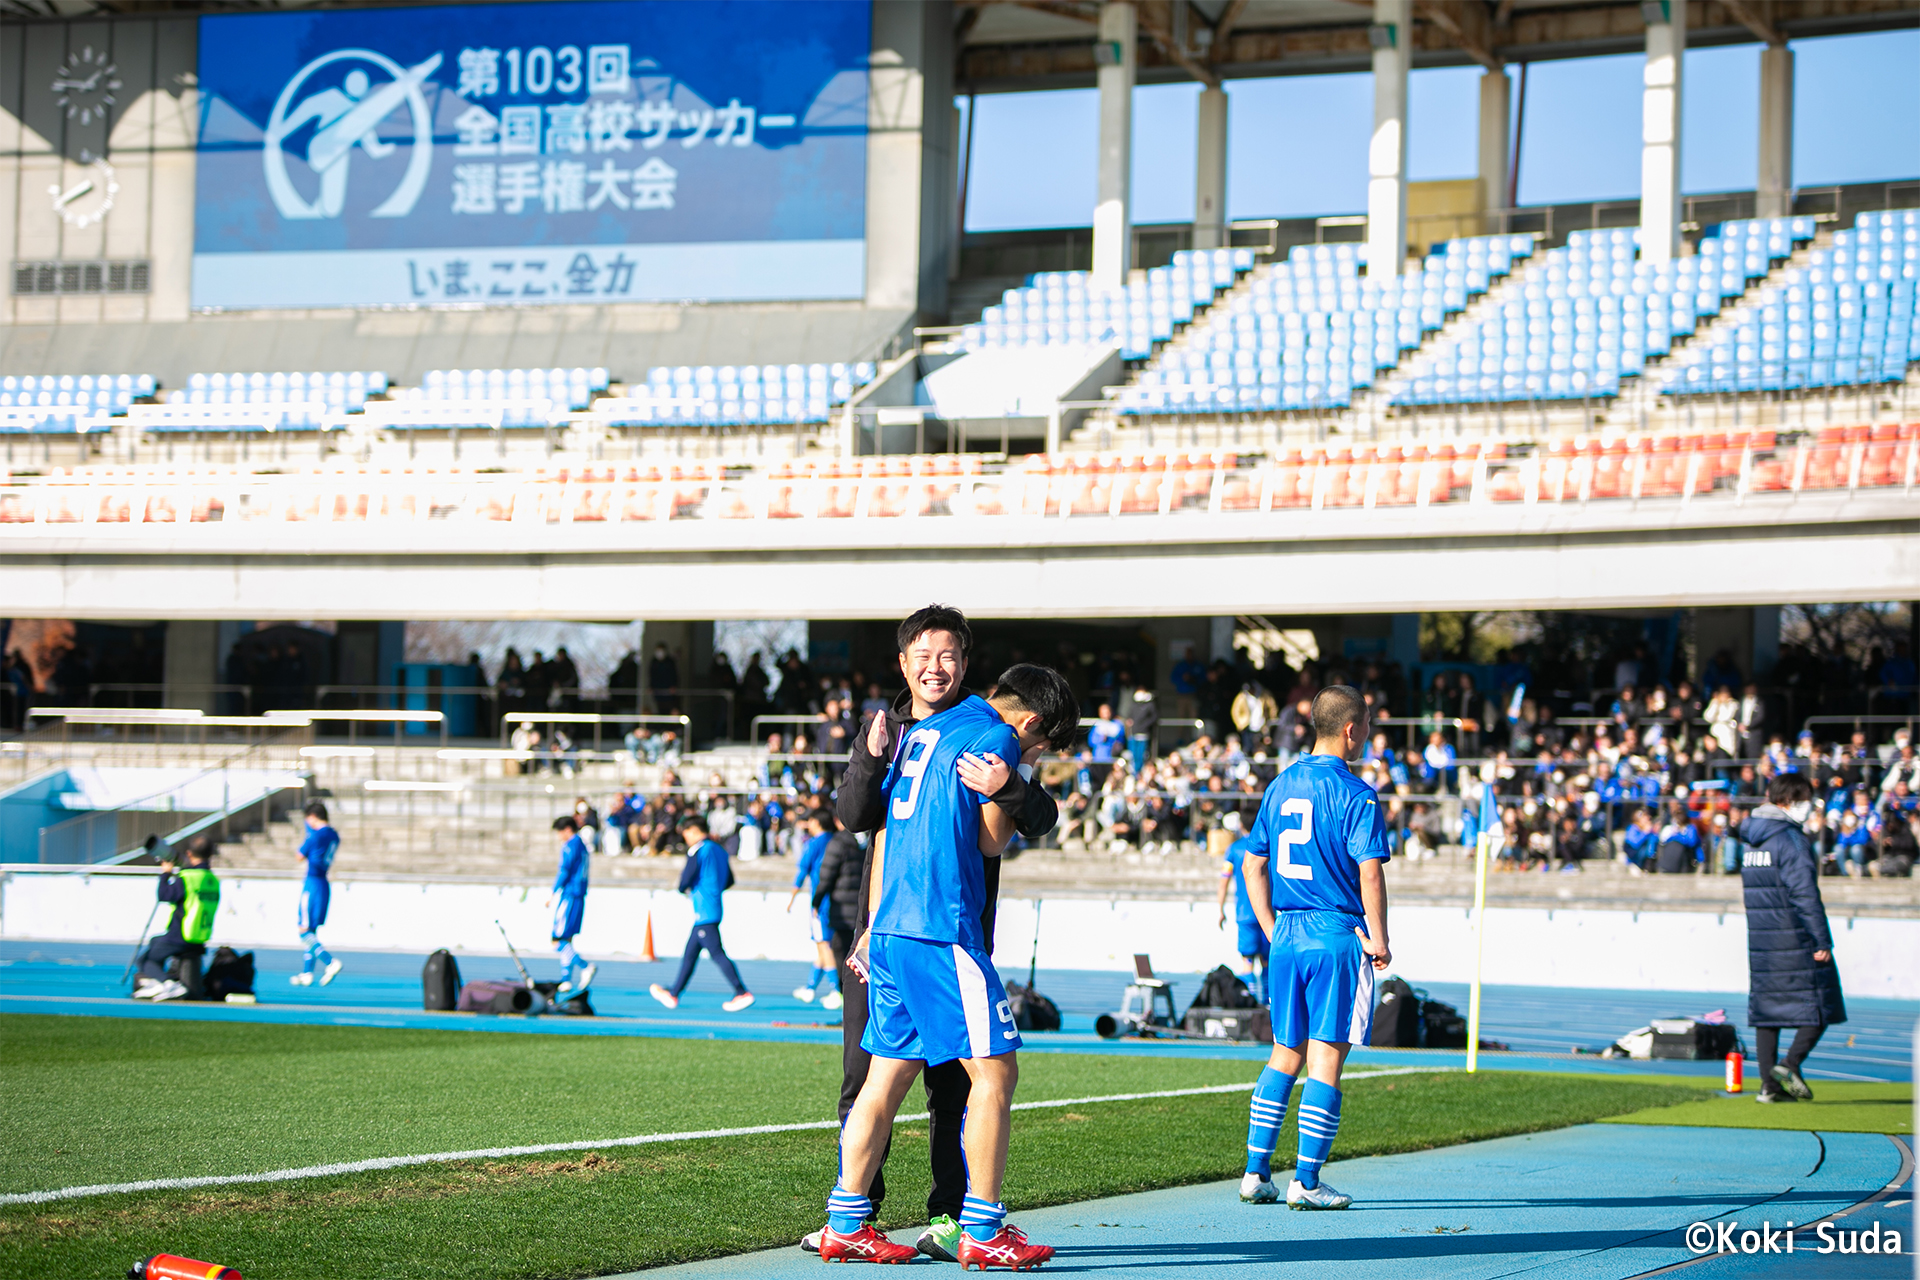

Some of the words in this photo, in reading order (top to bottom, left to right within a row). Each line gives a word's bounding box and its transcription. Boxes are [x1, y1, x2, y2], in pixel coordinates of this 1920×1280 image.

[456, 44, 630, 98] 第103回
[452, 98, 796, 156] 全国高校サッカー
[451, 156, 678, 214] 選手権大会
[892, 728, 941, 820] 9
[1276, 798, 1313, 881] 2
[995, 999, 1019, 1040] 9
